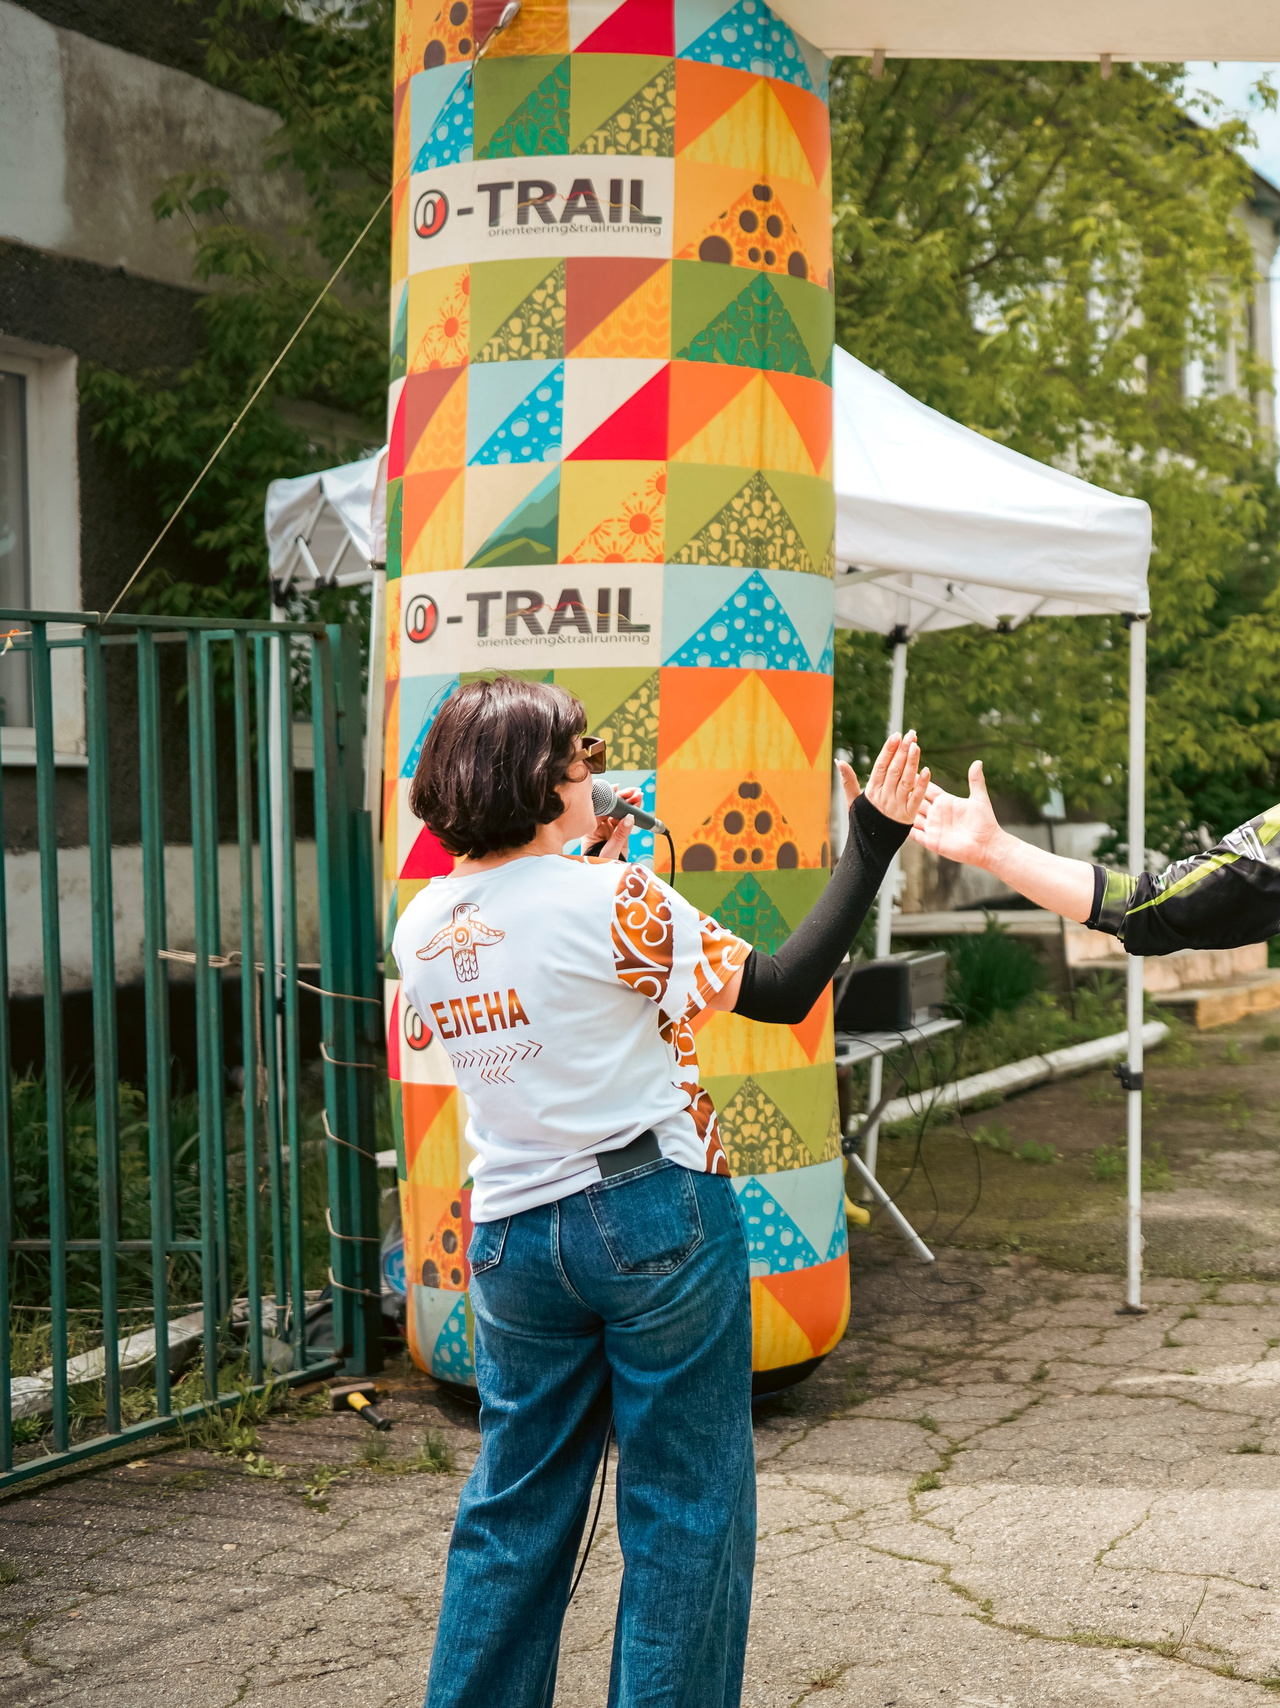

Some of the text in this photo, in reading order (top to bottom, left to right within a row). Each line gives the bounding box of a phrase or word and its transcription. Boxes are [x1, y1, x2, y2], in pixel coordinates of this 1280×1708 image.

[488, 222, 662, 237] orienteering&trailrunning
[477, 632, 651, 648] orienteering&trailrunning
[430, 988, 531, 1040] ЕЛЕНА
